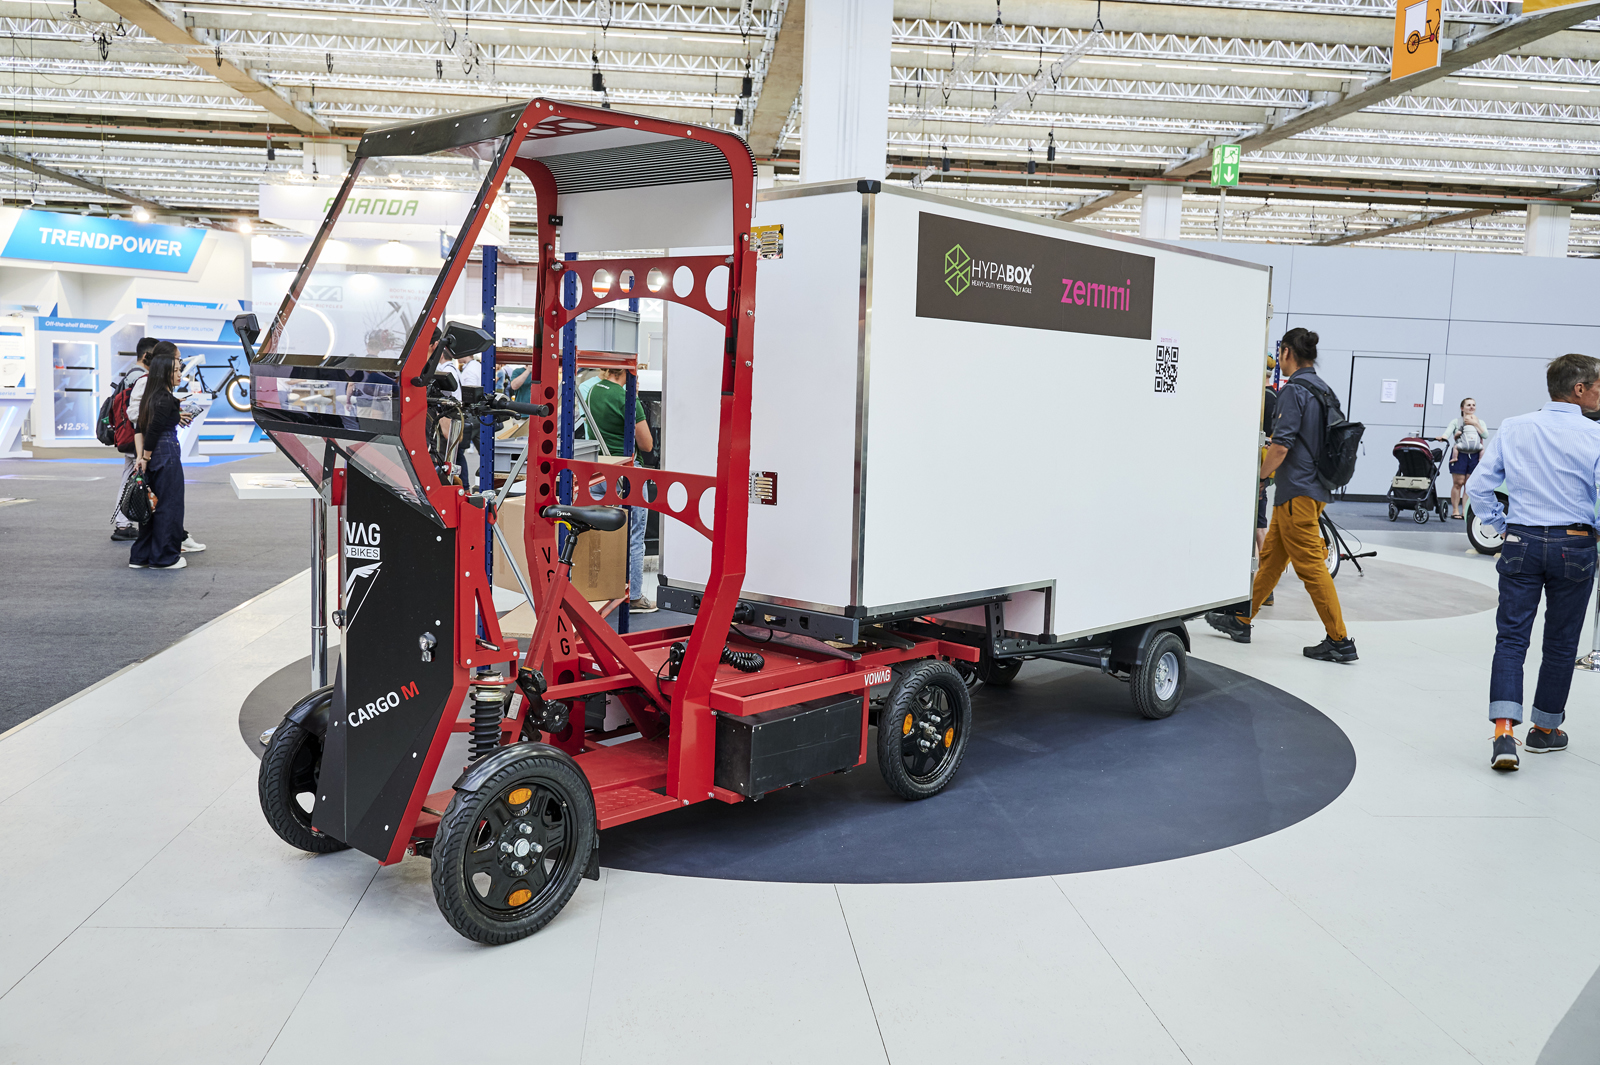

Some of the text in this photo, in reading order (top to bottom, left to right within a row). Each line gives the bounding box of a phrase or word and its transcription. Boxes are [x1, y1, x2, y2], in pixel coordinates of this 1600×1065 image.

[39, 227, 182, 257] TRENDPOWER
[972, 280, 996, 288] HEAVY-DUTY
[1003, 284, 1022, 292] PERFECTLY
[1061, 279, 1131, 311] zemmi
[45, 320, 99, 330] Off-the-shelf Battery
[57, 422, 89, 431] +12.5%
[350, 547, 379, 558] BIKES
[864, 669, 891, 686] VOWAG
[347, 680, 420, 728] CARGO M
